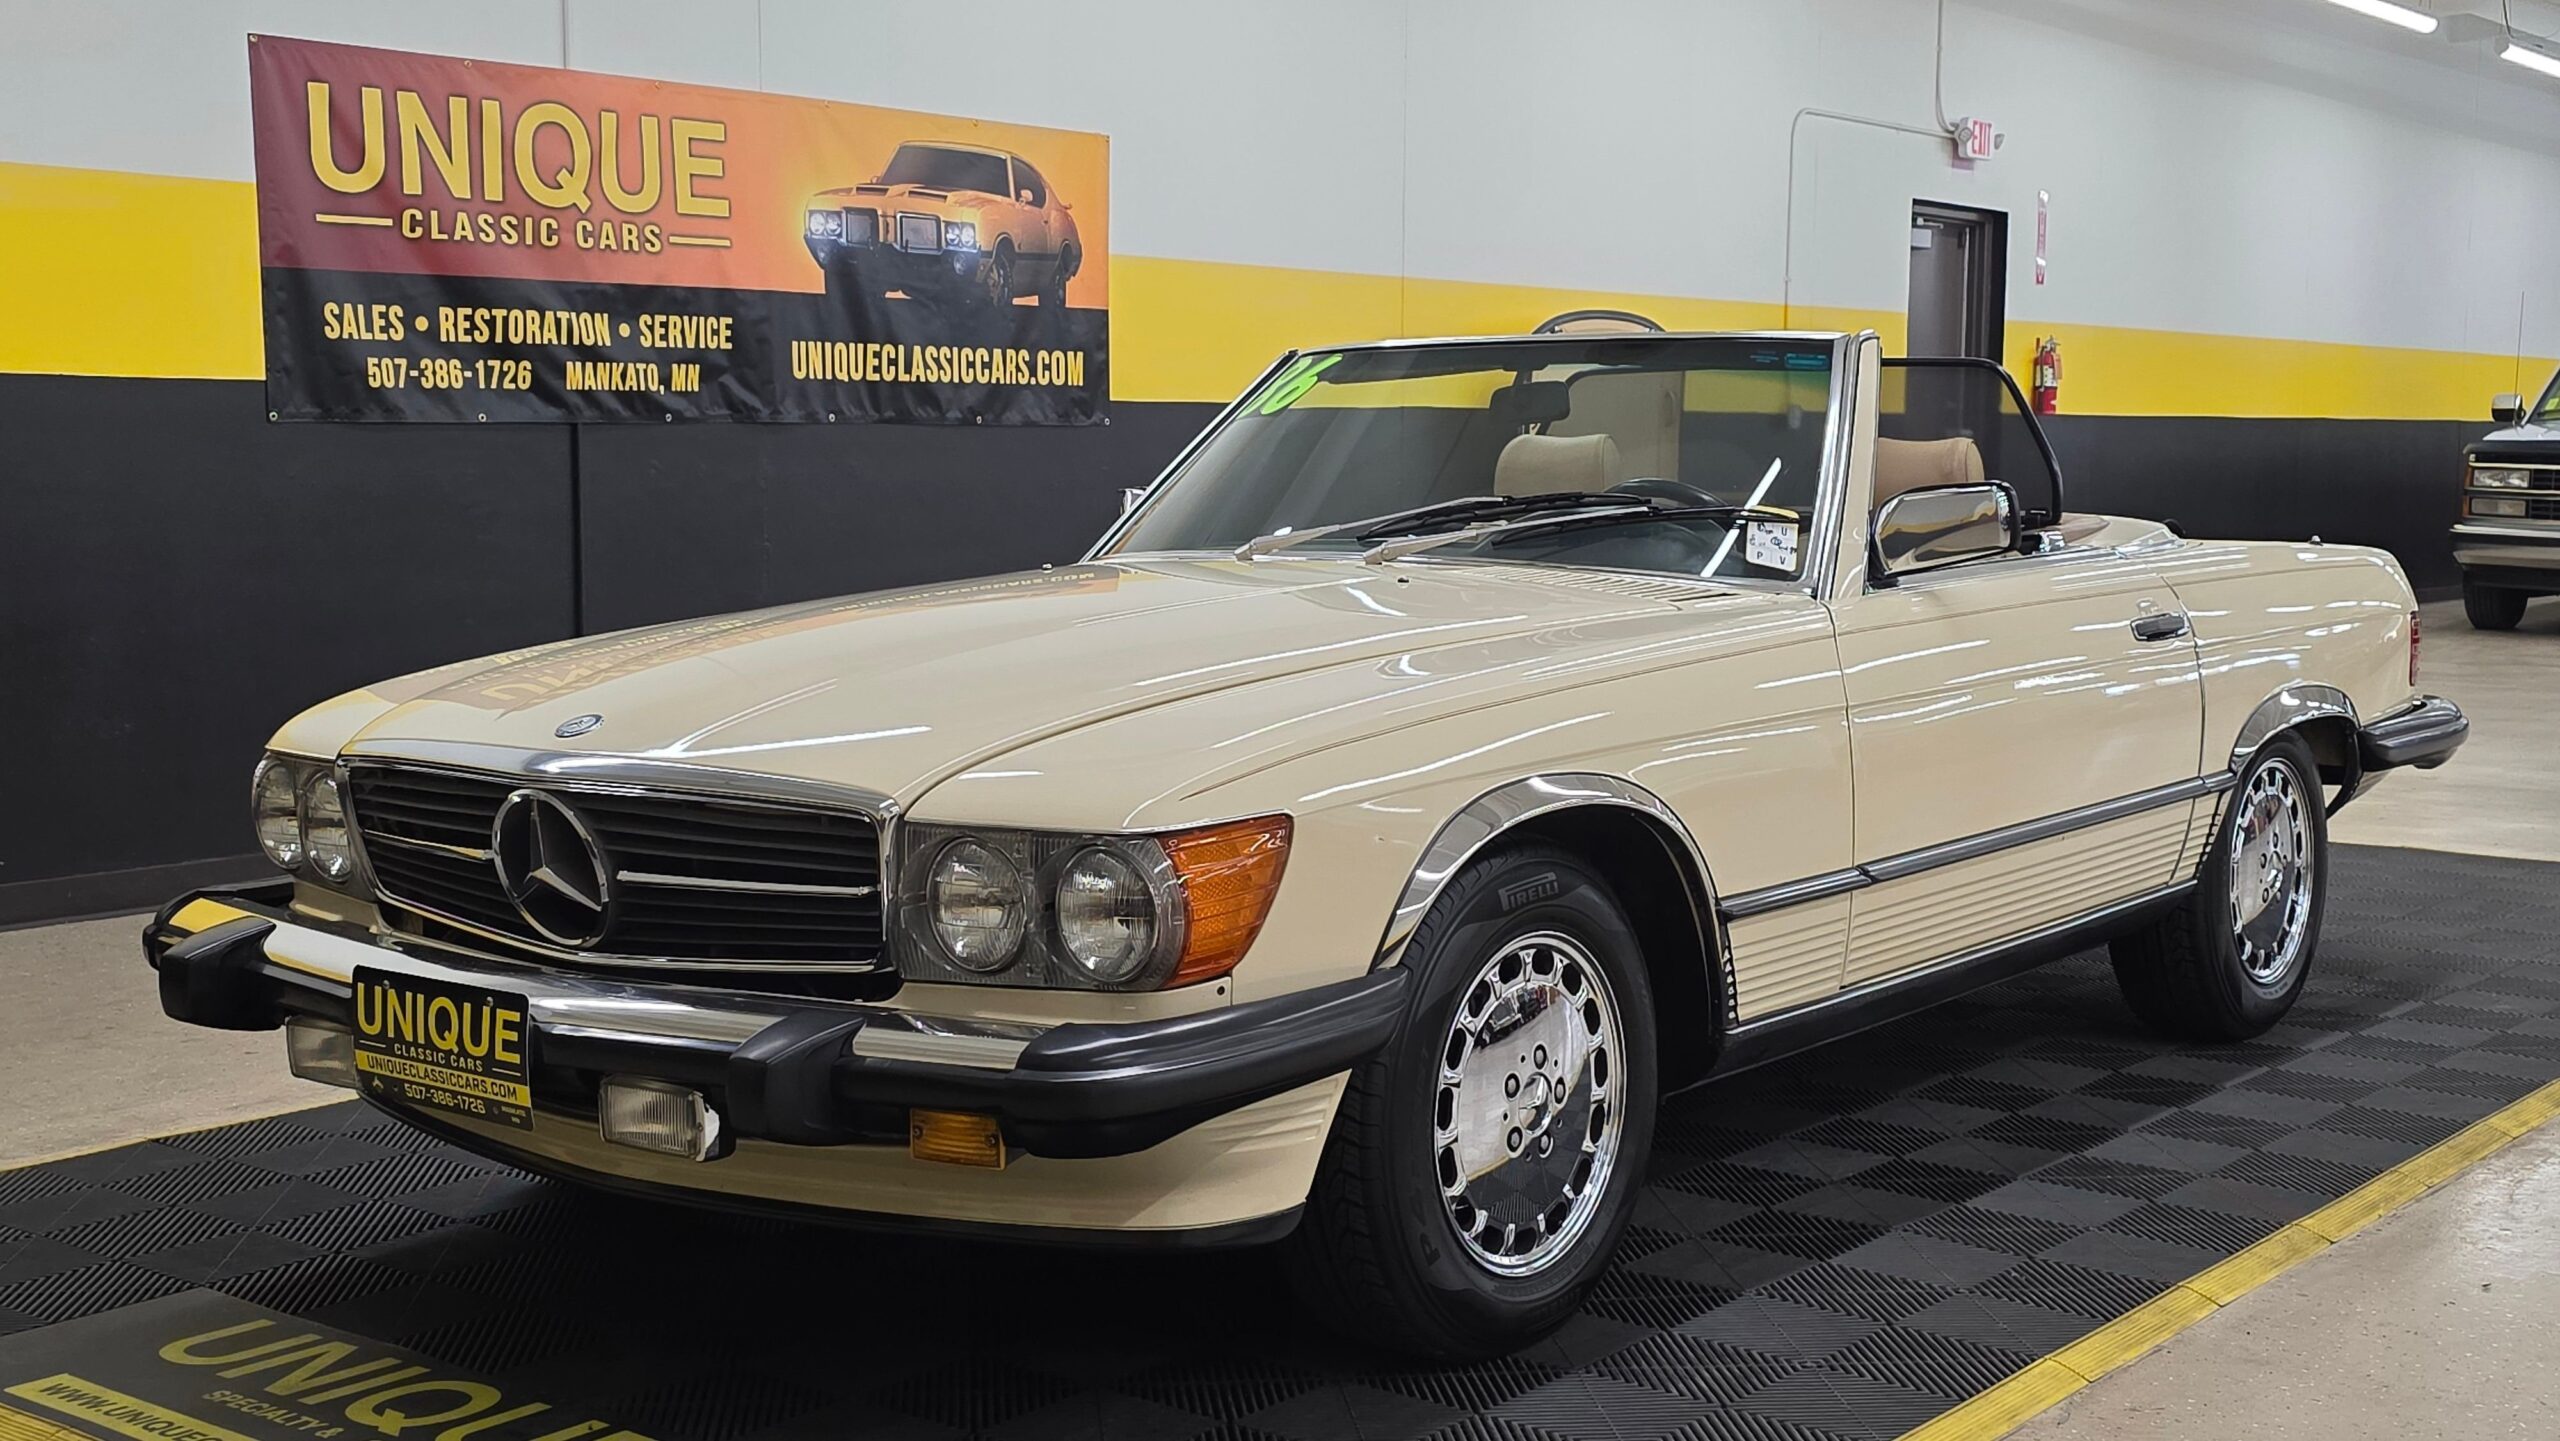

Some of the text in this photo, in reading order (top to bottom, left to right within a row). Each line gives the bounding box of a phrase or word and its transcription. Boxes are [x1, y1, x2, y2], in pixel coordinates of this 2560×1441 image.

[306, 81, 731, 218] UNIQUE
[1972, 120, 1992, 156] EXIT
[401, 208, 662, 253] CLASSIC CARS
[322, 301, 734, 350] SALES RESTORATION SERVICE
[366, 356, 701, 395] 507-386-1726 MANKATO, MN
[791, 340, 1084, 387] UNIQUECLASSICCARS.COM
[1498, 871, 1560, 912] PIRELLI
[357, 982, 521, 1064] UNIQUE
[366, 1054, 518, 1101] UNIQUECLASSICCARS.COM
[393, 1042, 484, 1073] CLASSIC CARS
[403, 1083, 487, 1114] 507-386-1726
[158, 1319, 658, 1441] UNIQU
[202, 1389, 345, 1439] SPECIALTY &
